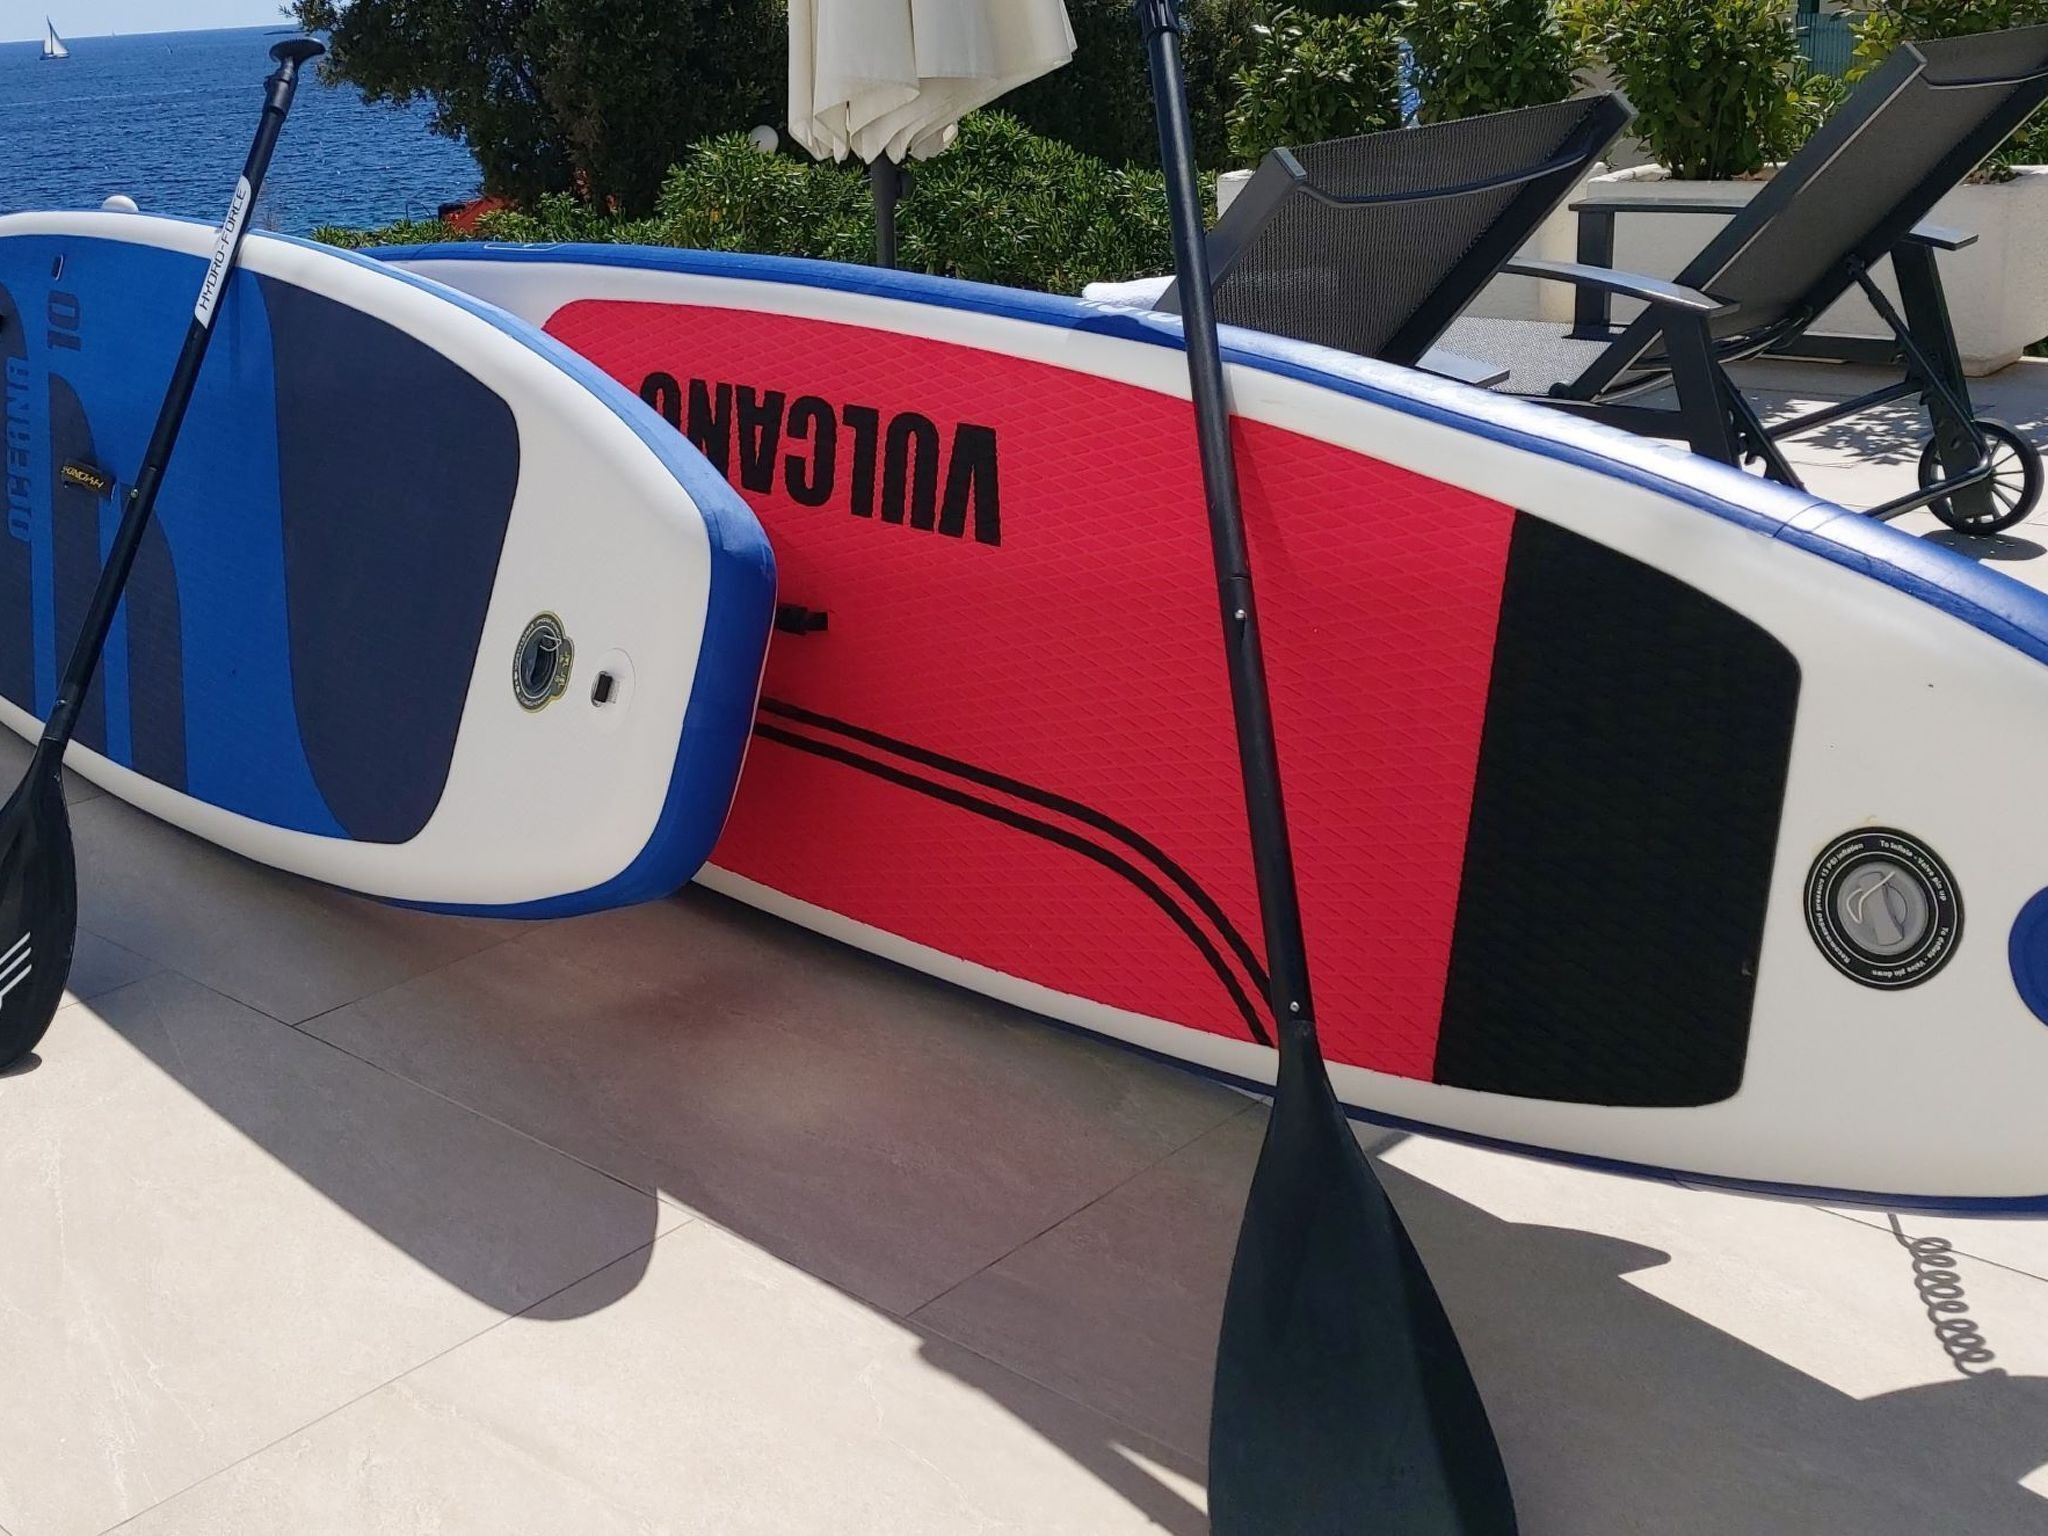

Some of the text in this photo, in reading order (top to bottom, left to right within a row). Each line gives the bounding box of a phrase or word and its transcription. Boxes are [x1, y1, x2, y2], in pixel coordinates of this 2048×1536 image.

[199, 188, 247, 310] HYDRO-FORCE
[6, 290, 81, 543] OCEANA 10
